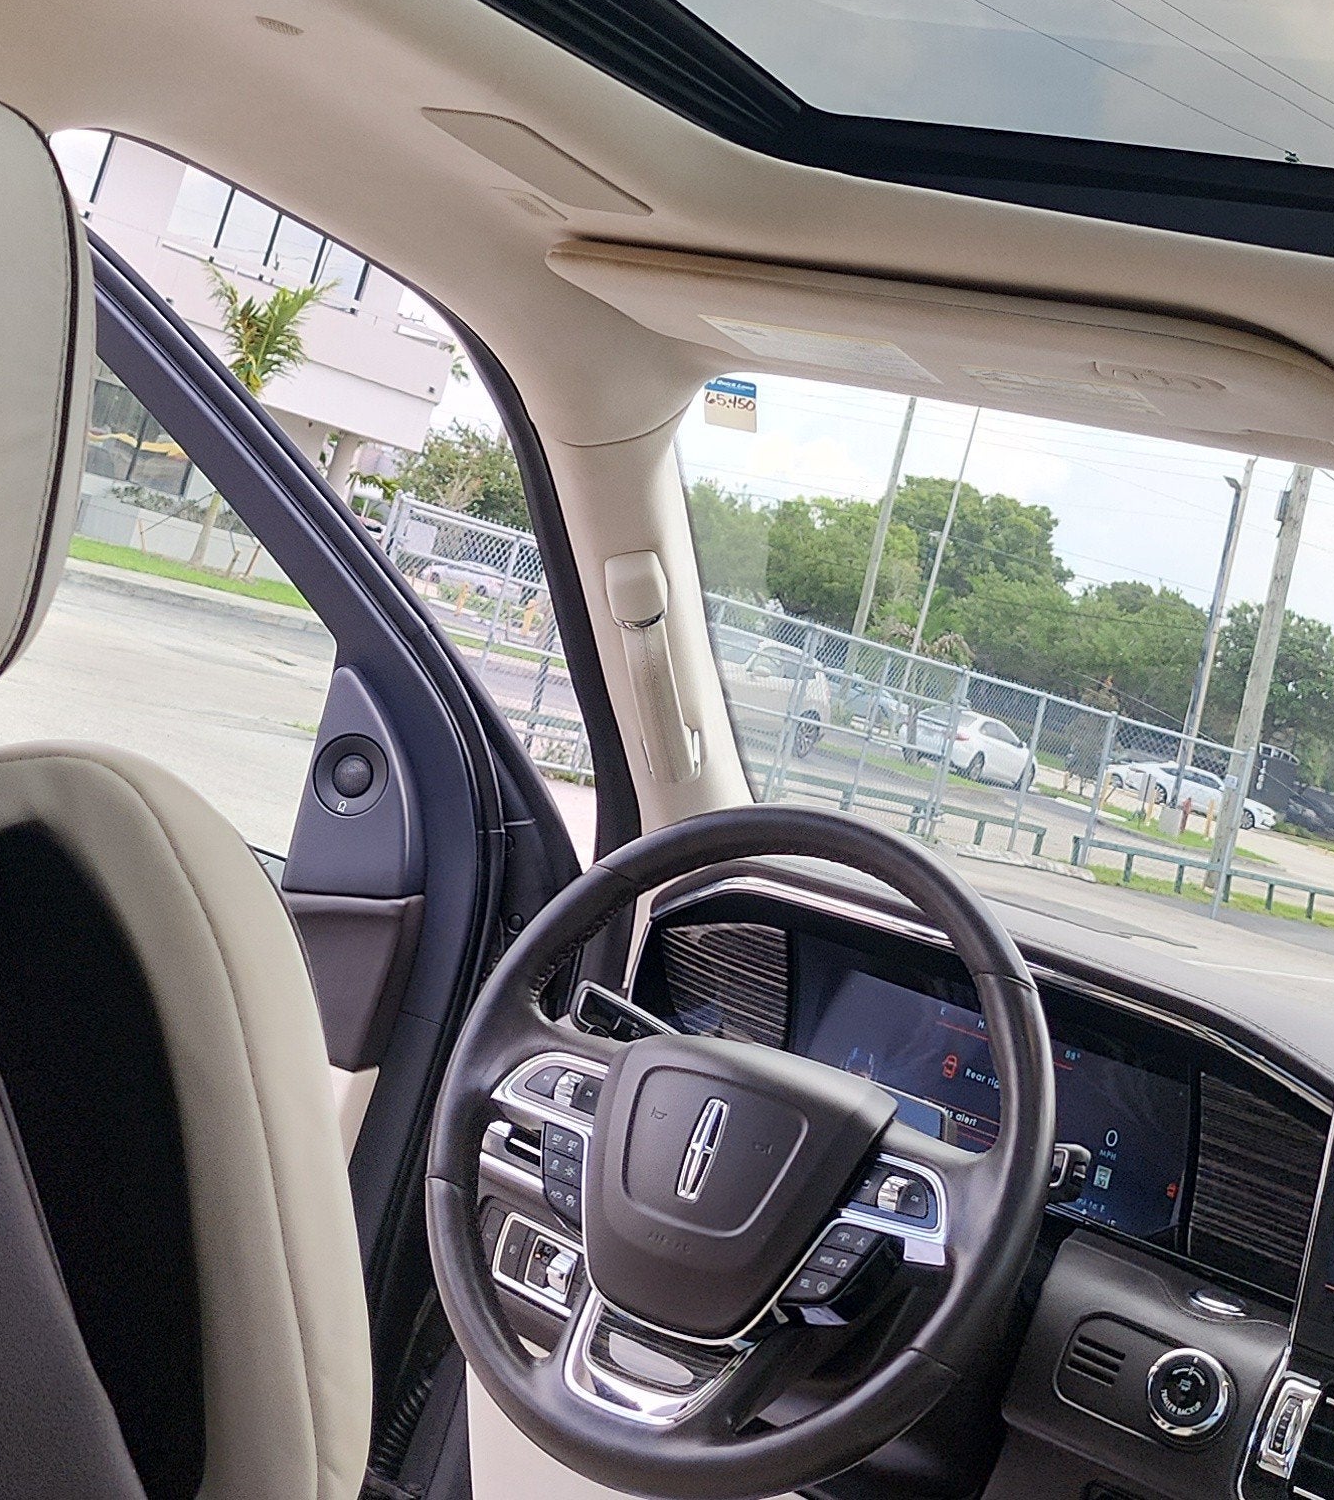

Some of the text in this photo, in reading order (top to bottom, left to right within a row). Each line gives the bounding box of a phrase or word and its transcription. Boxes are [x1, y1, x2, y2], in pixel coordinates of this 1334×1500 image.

[965, 1068, 986, 1084] Rear
[955, 1110, 978, 1127] alert
[1105, 1129, 1118, 1147] 0
[1099, 1149, 1117, 1161] MPH
